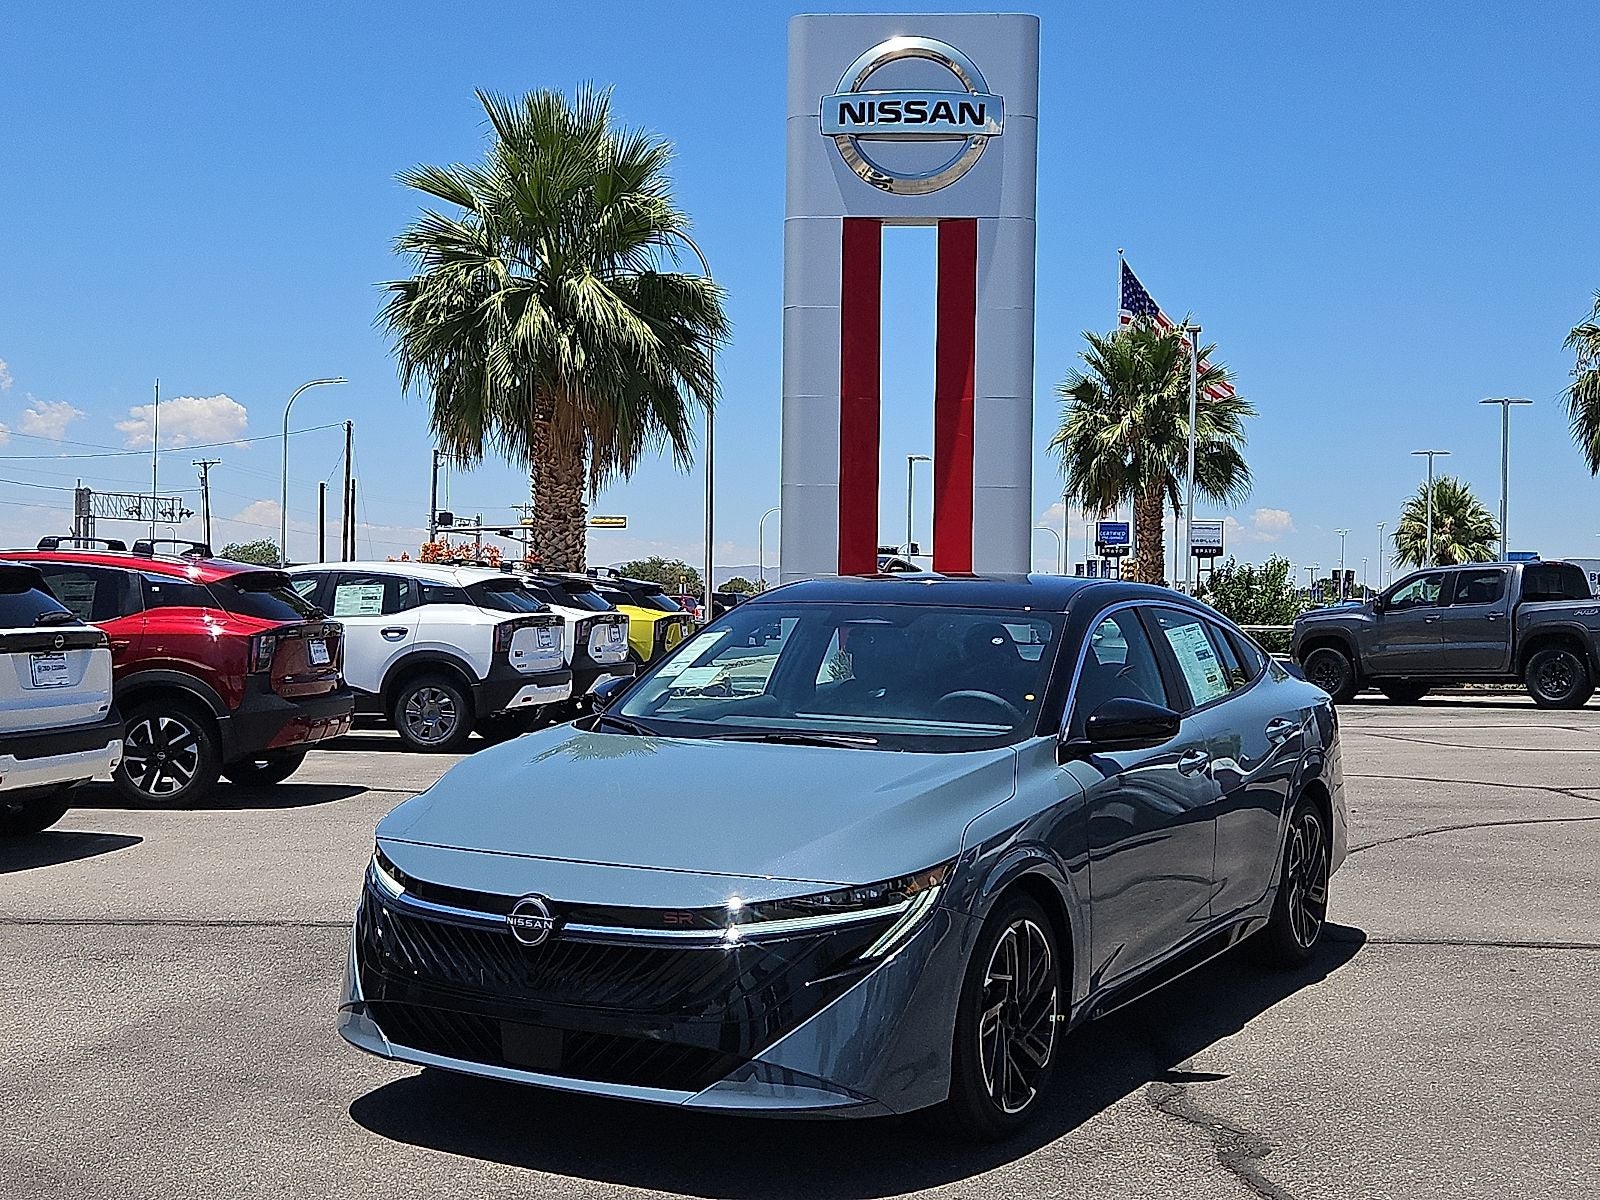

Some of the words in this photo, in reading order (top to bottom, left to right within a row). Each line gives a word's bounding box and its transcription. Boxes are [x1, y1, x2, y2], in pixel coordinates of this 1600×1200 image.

[838, 100, 986, 126] NISSAN
[506, 916, 553, 929] NISSAN
[663, 911, 695, 924] SR
